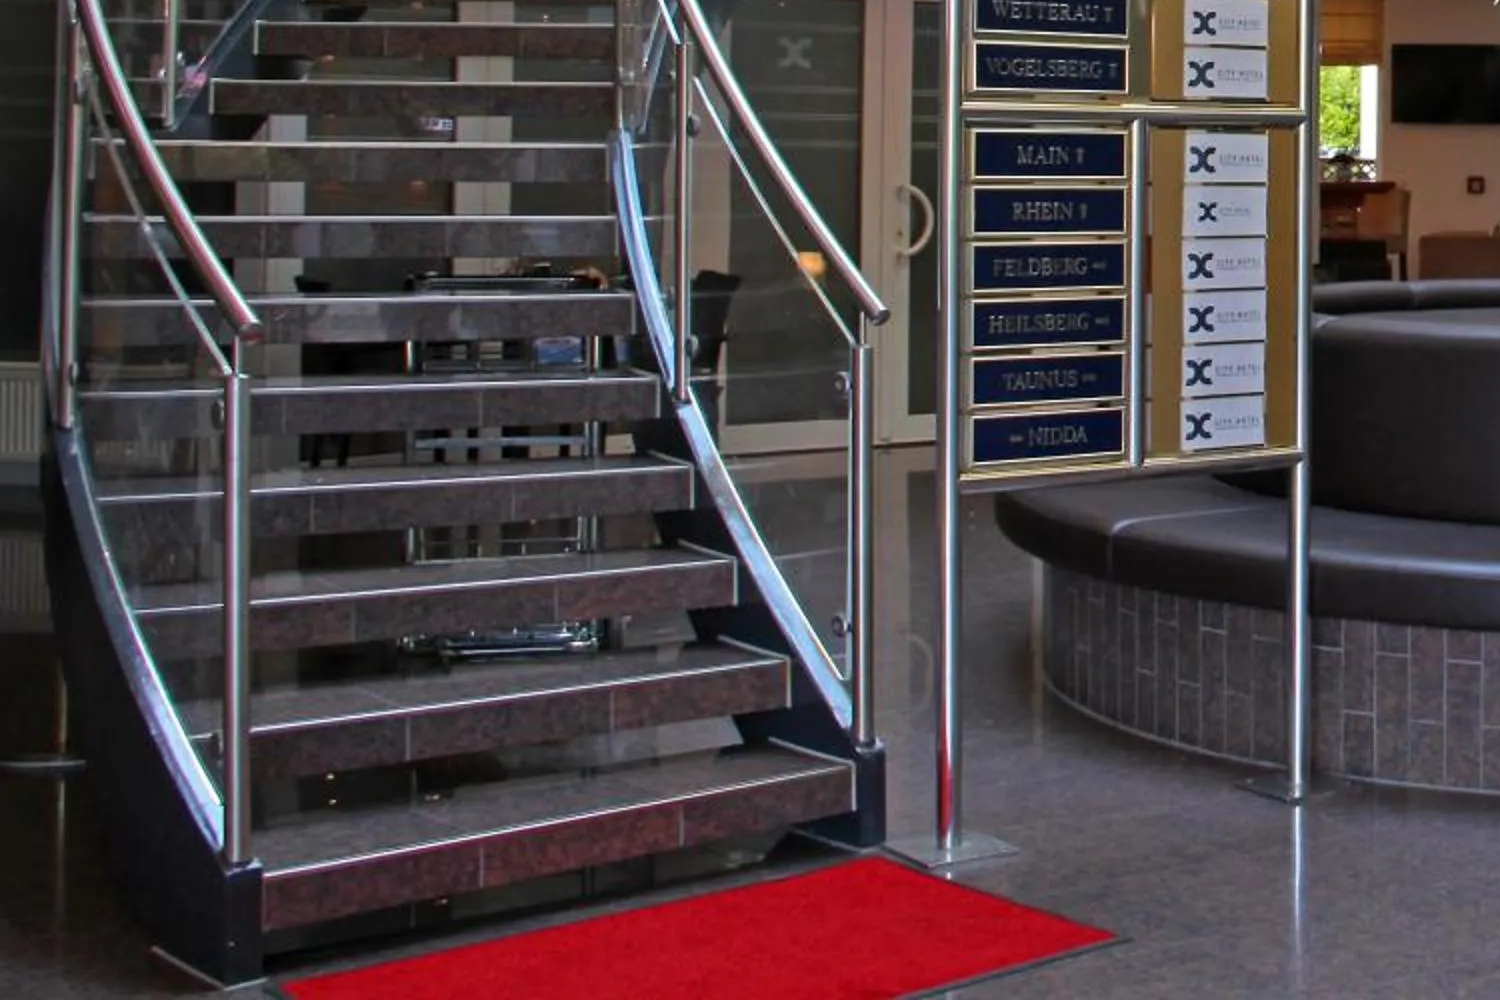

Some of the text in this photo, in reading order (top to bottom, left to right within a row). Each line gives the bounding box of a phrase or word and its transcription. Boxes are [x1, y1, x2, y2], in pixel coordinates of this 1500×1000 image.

[984, 55, 1104, 79] VOGELSBERG
[1016, 144, 1071, 167] MAIN
[1011, 199, 1075, 222] RHEIN
[992, 255, 1089, 277] FELDBERG
[988, 312, 1091, 335] HEILSBERG
[1002, 368, 1080, 390] TAUNUS
[1028, 424, 1088, 447] NIDDA
